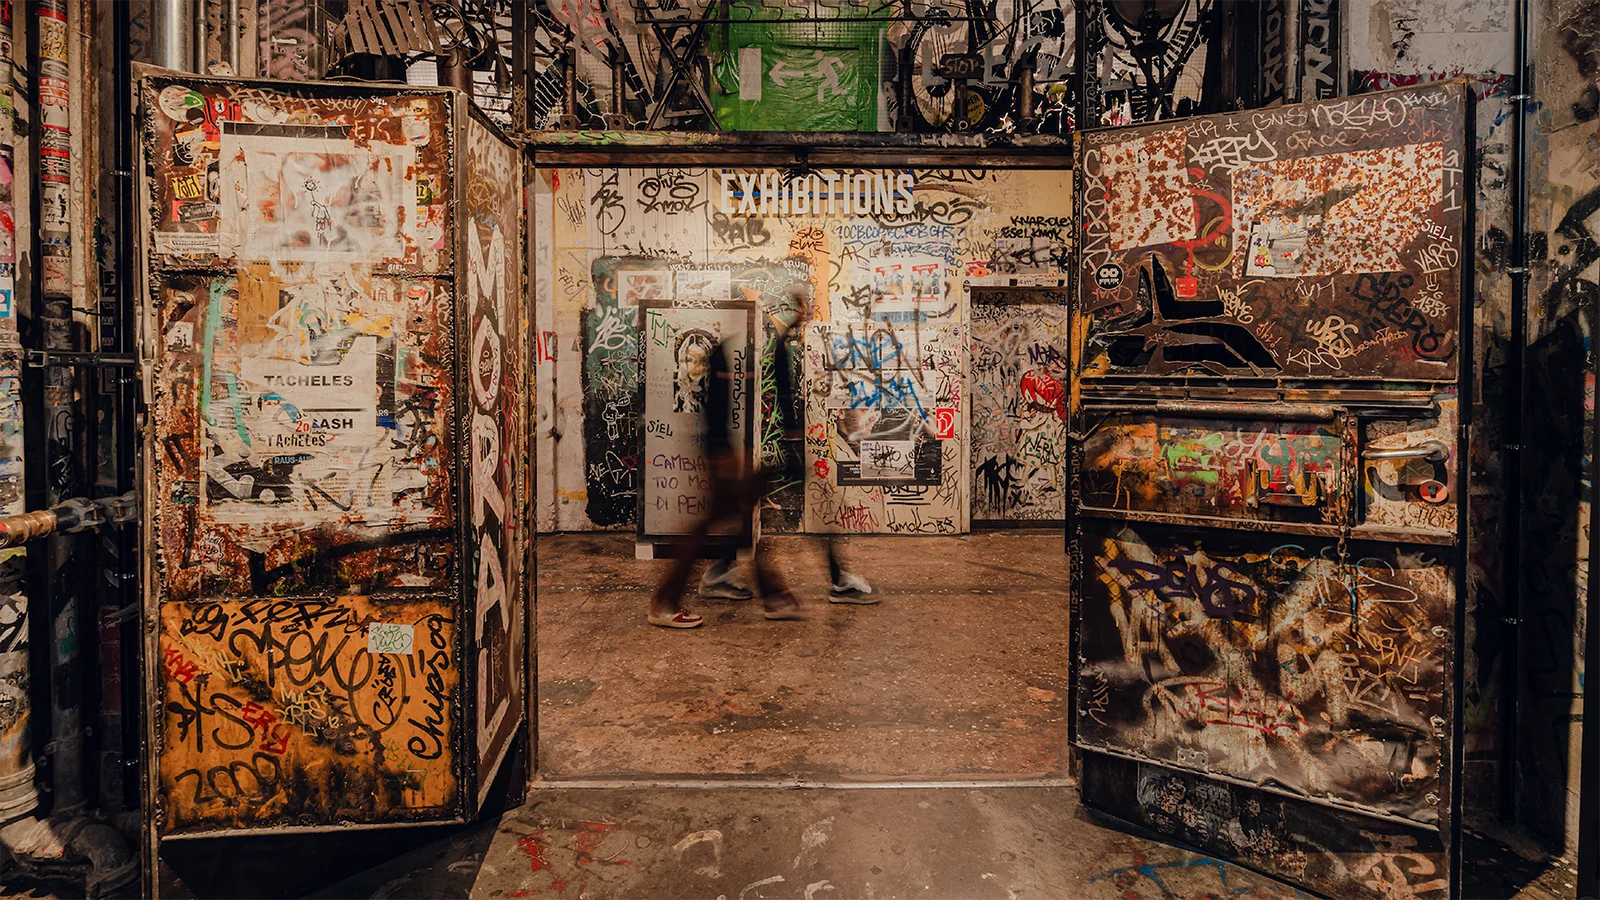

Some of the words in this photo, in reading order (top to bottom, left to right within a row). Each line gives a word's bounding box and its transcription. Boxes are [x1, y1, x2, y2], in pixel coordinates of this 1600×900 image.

[944, 56, 980, 75] STOP
[720, 172, 915, 216] EXHIBITIONS
[264, 375, 353, 387] TACHELES
[647, 419, 673, 440] SiEL
